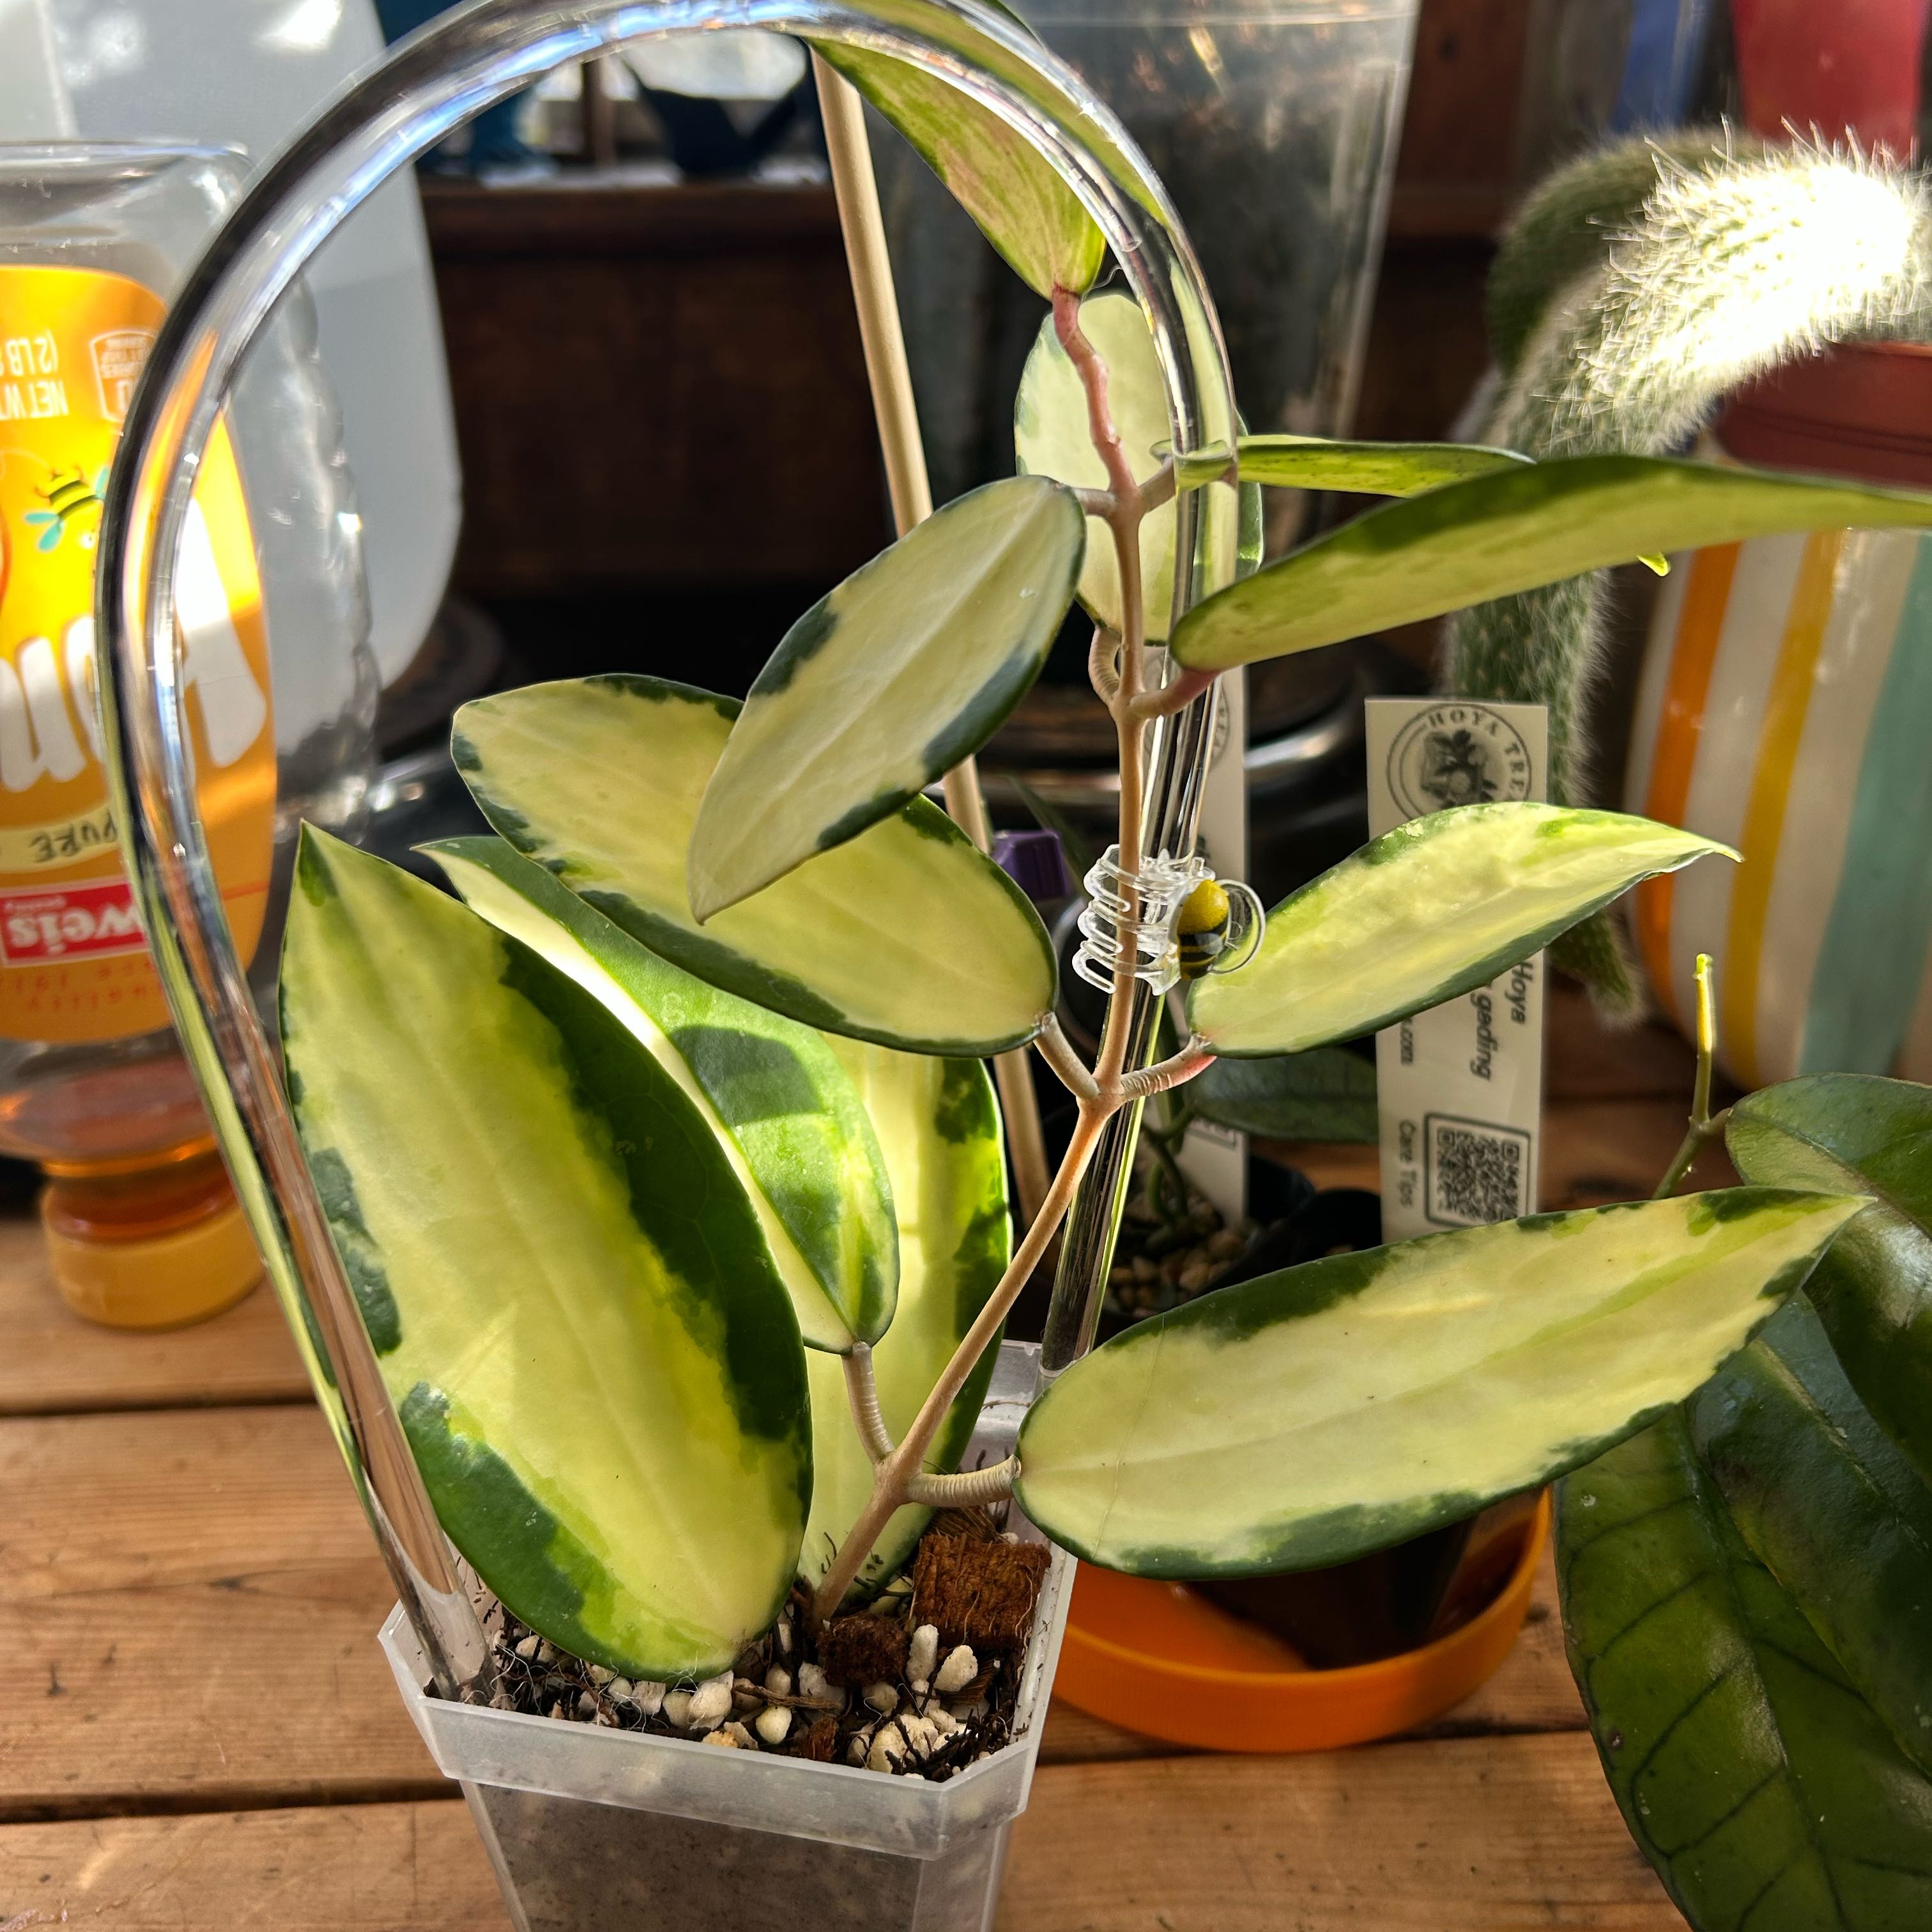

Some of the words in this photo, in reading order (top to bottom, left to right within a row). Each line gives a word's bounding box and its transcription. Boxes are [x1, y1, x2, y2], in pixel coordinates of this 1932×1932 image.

[6, 338, 36, 376] LB
[29, 379, 69, 419] NET
[29, 808, 118, 862] PURE
[8, 905, 144, 954] weis
[1505, 960, 1534, 1023] Hoya
[1471, 993, 1498, 1080] gading
[1399, 1120, 1416, 1163] Care
[1398, 1170, 1417, 1208] Tips
